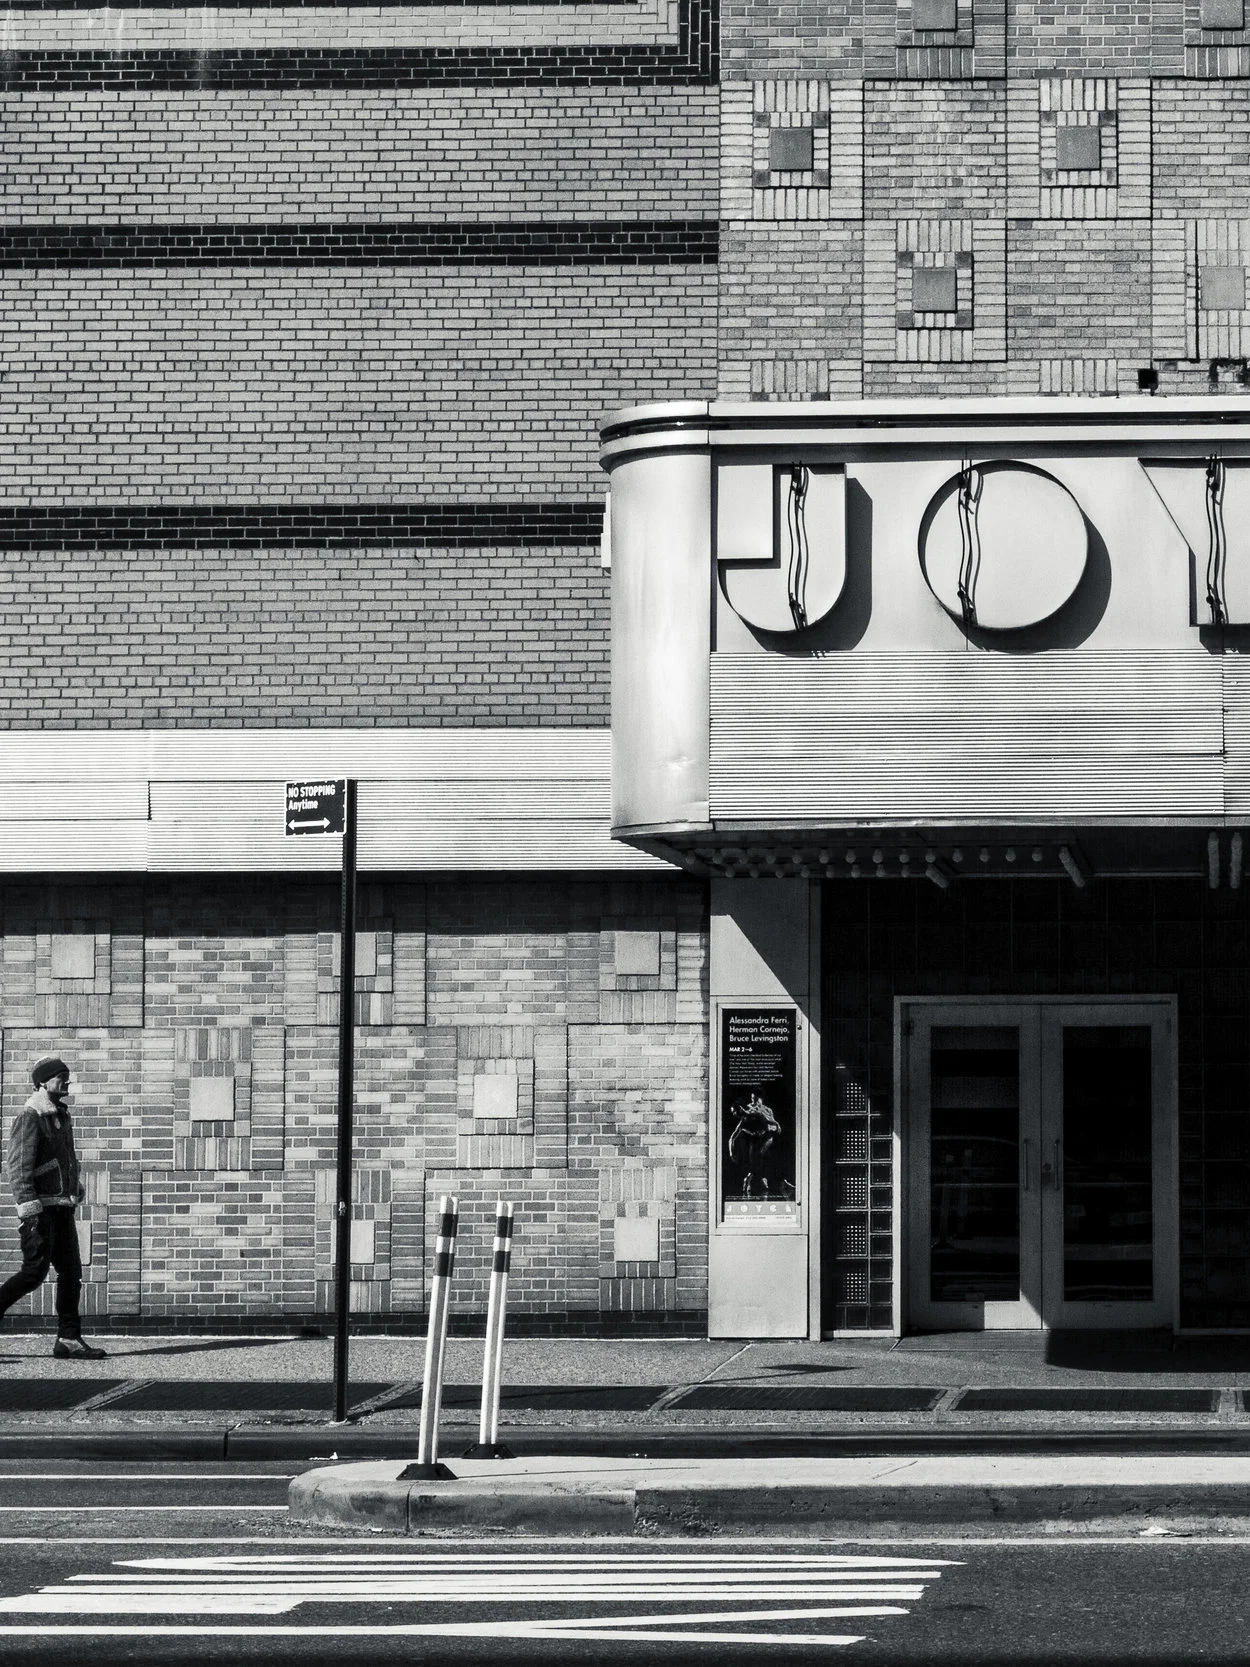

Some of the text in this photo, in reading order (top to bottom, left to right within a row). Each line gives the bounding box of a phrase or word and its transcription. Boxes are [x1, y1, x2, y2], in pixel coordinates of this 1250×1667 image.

[288, 784, 336, 798] NO STOPPING
[288, 799, 318, 812] Anytime
[729, 1016, 789, 1025] Alessandra Ferri,
[729, 1025, 790, 1034] Herman Cornejo,
[729, 1034, 788, 1043] Bruce Levingston
